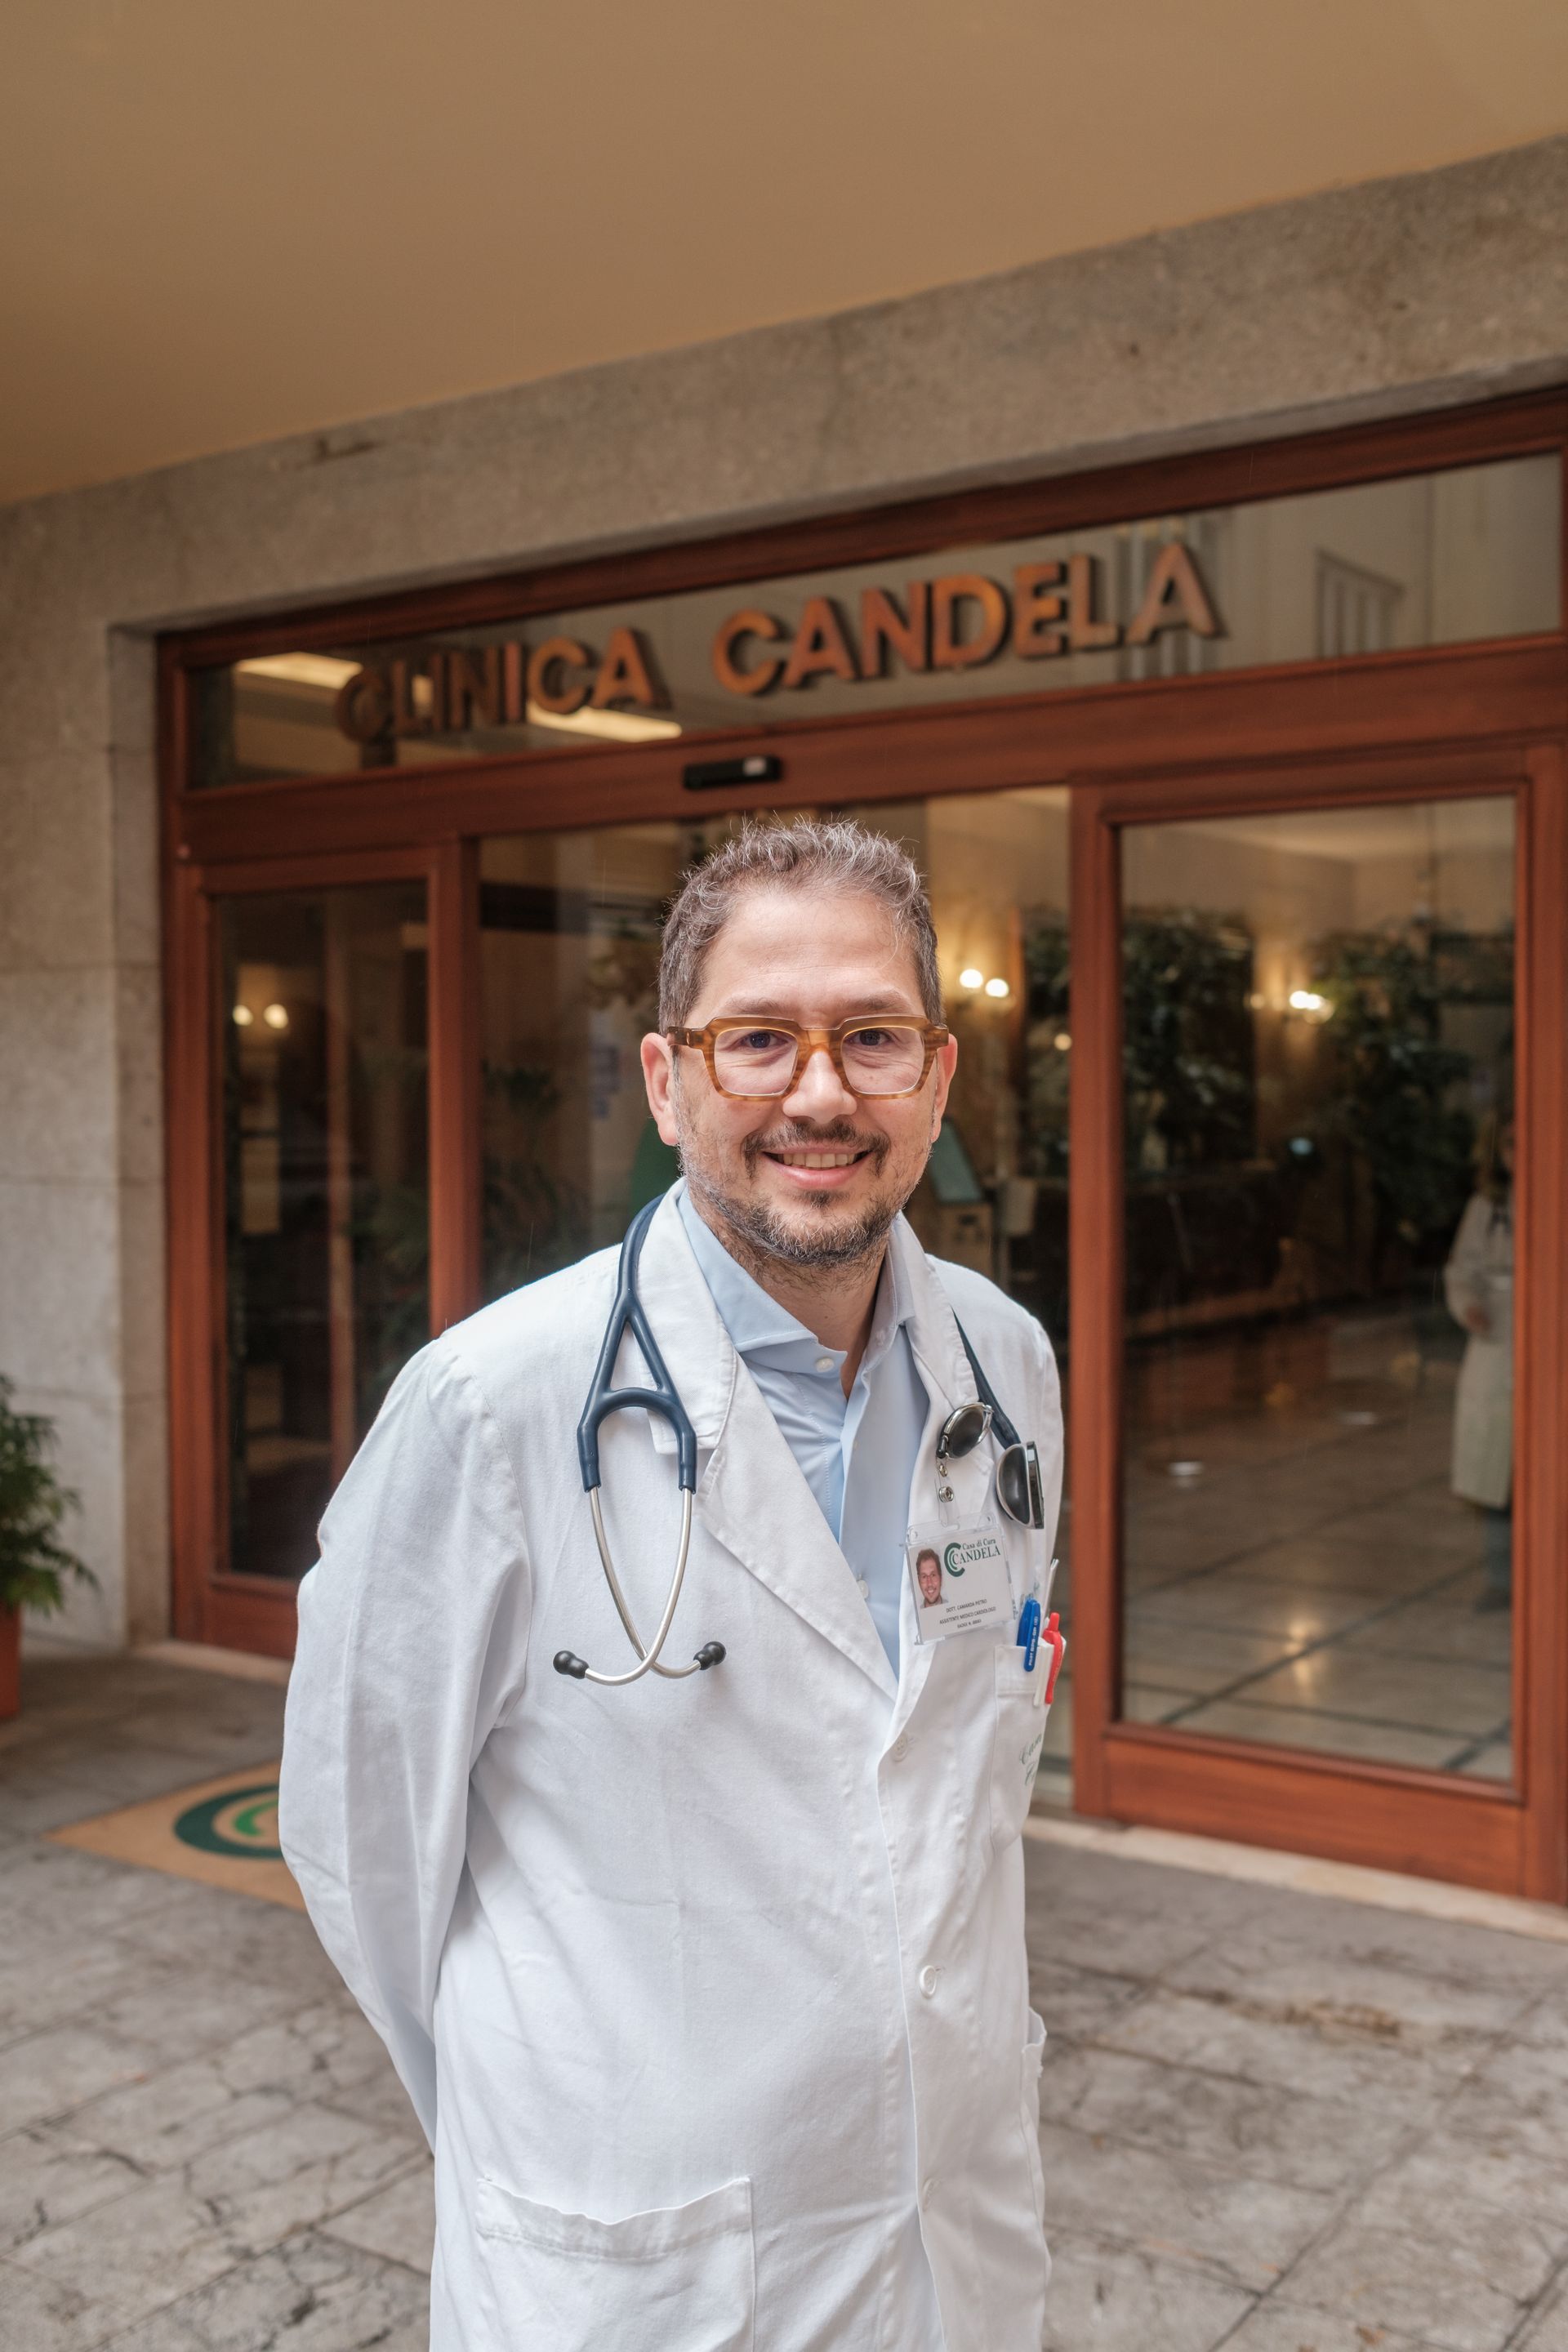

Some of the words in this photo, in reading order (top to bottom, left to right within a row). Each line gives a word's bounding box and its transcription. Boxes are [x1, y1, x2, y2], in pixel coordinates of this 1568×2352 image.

[336, 627, 656, 742] CLINICA
[712, 542, 1220, 696] CANDELA
[952, 1544, 1000, 1565] CANDELA
